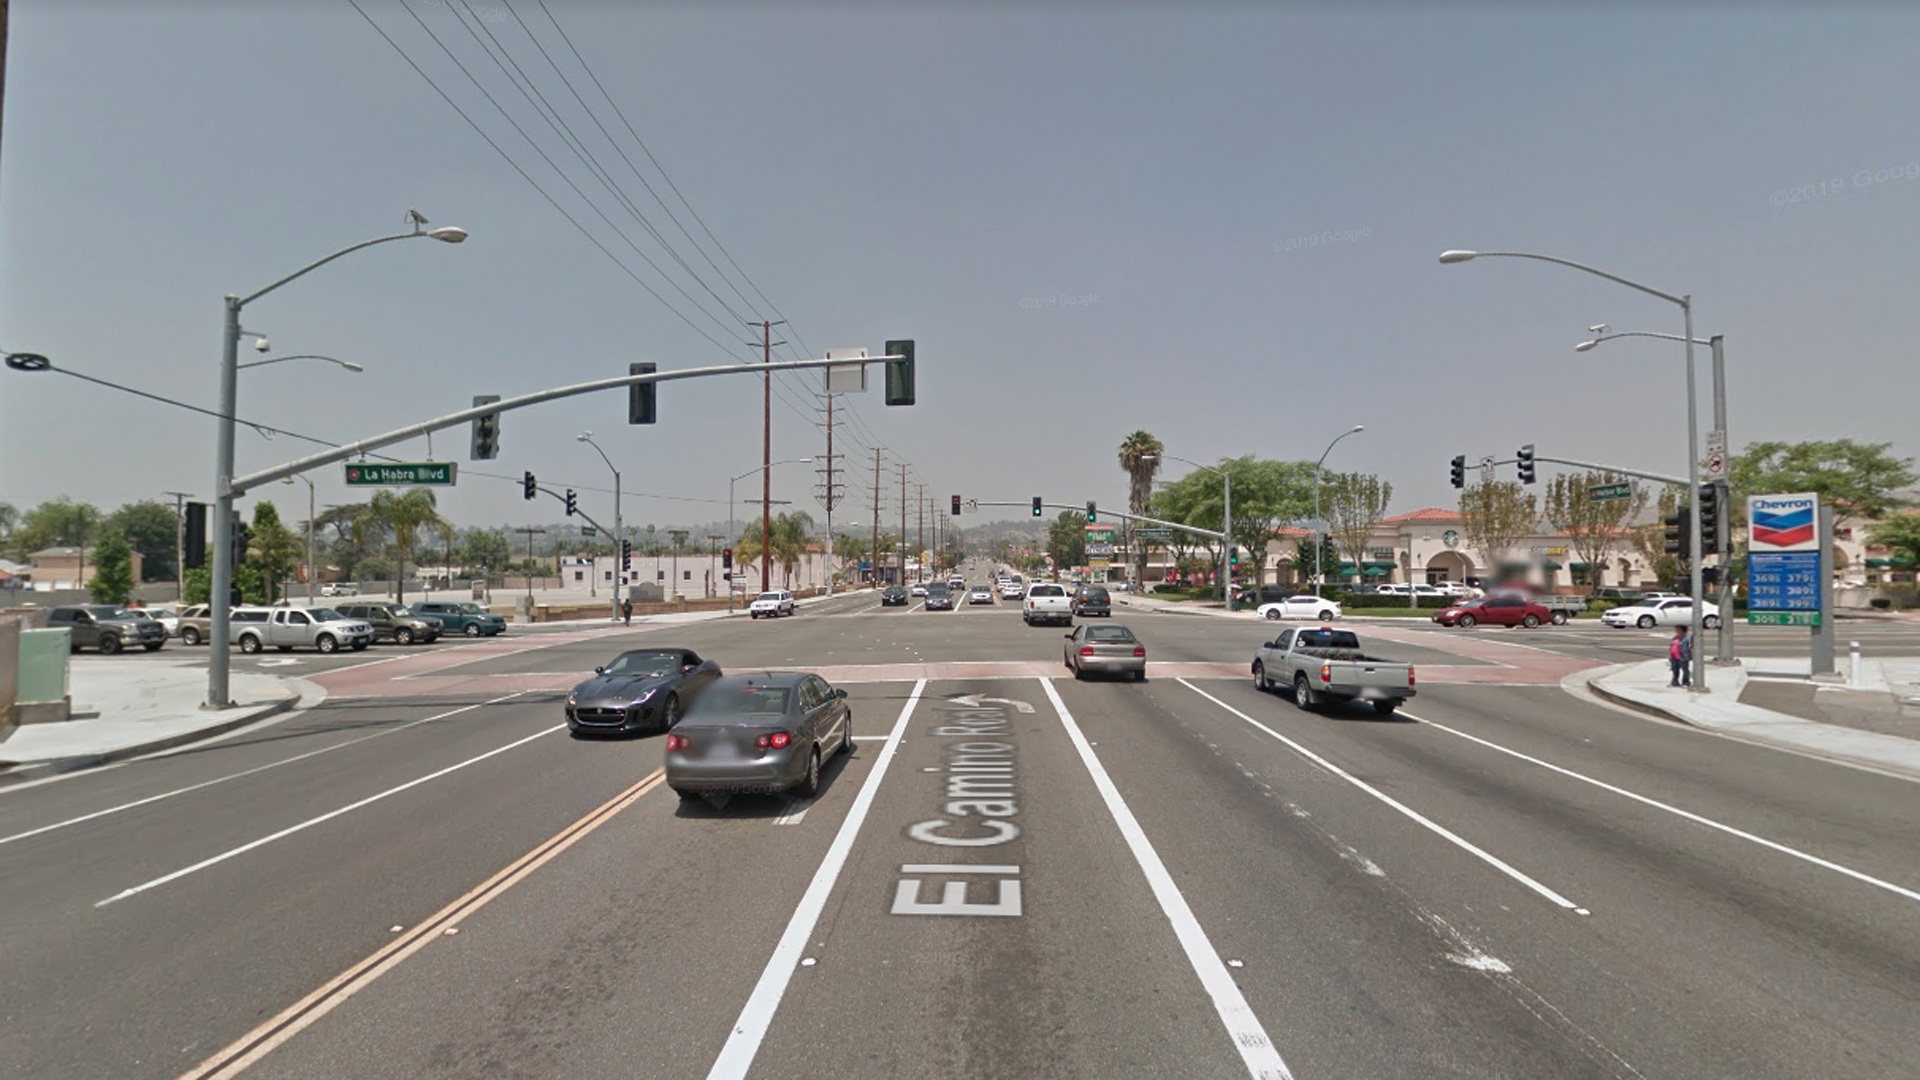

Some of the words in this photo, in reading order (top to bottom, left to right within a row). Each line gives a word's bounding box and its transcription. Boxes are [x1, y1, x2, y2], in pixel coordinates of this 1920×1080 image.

[364, 469, 379, 480] La
[381, 468, 415, 480] Habra
[418, 468, 445, 480] Blvd
[1752, 499, 1813, 509] Chevron
[925, 706, 1015, 737] Real
[907, 741, 1021, 847] Camino
[890, 863, 1023, 917] El
